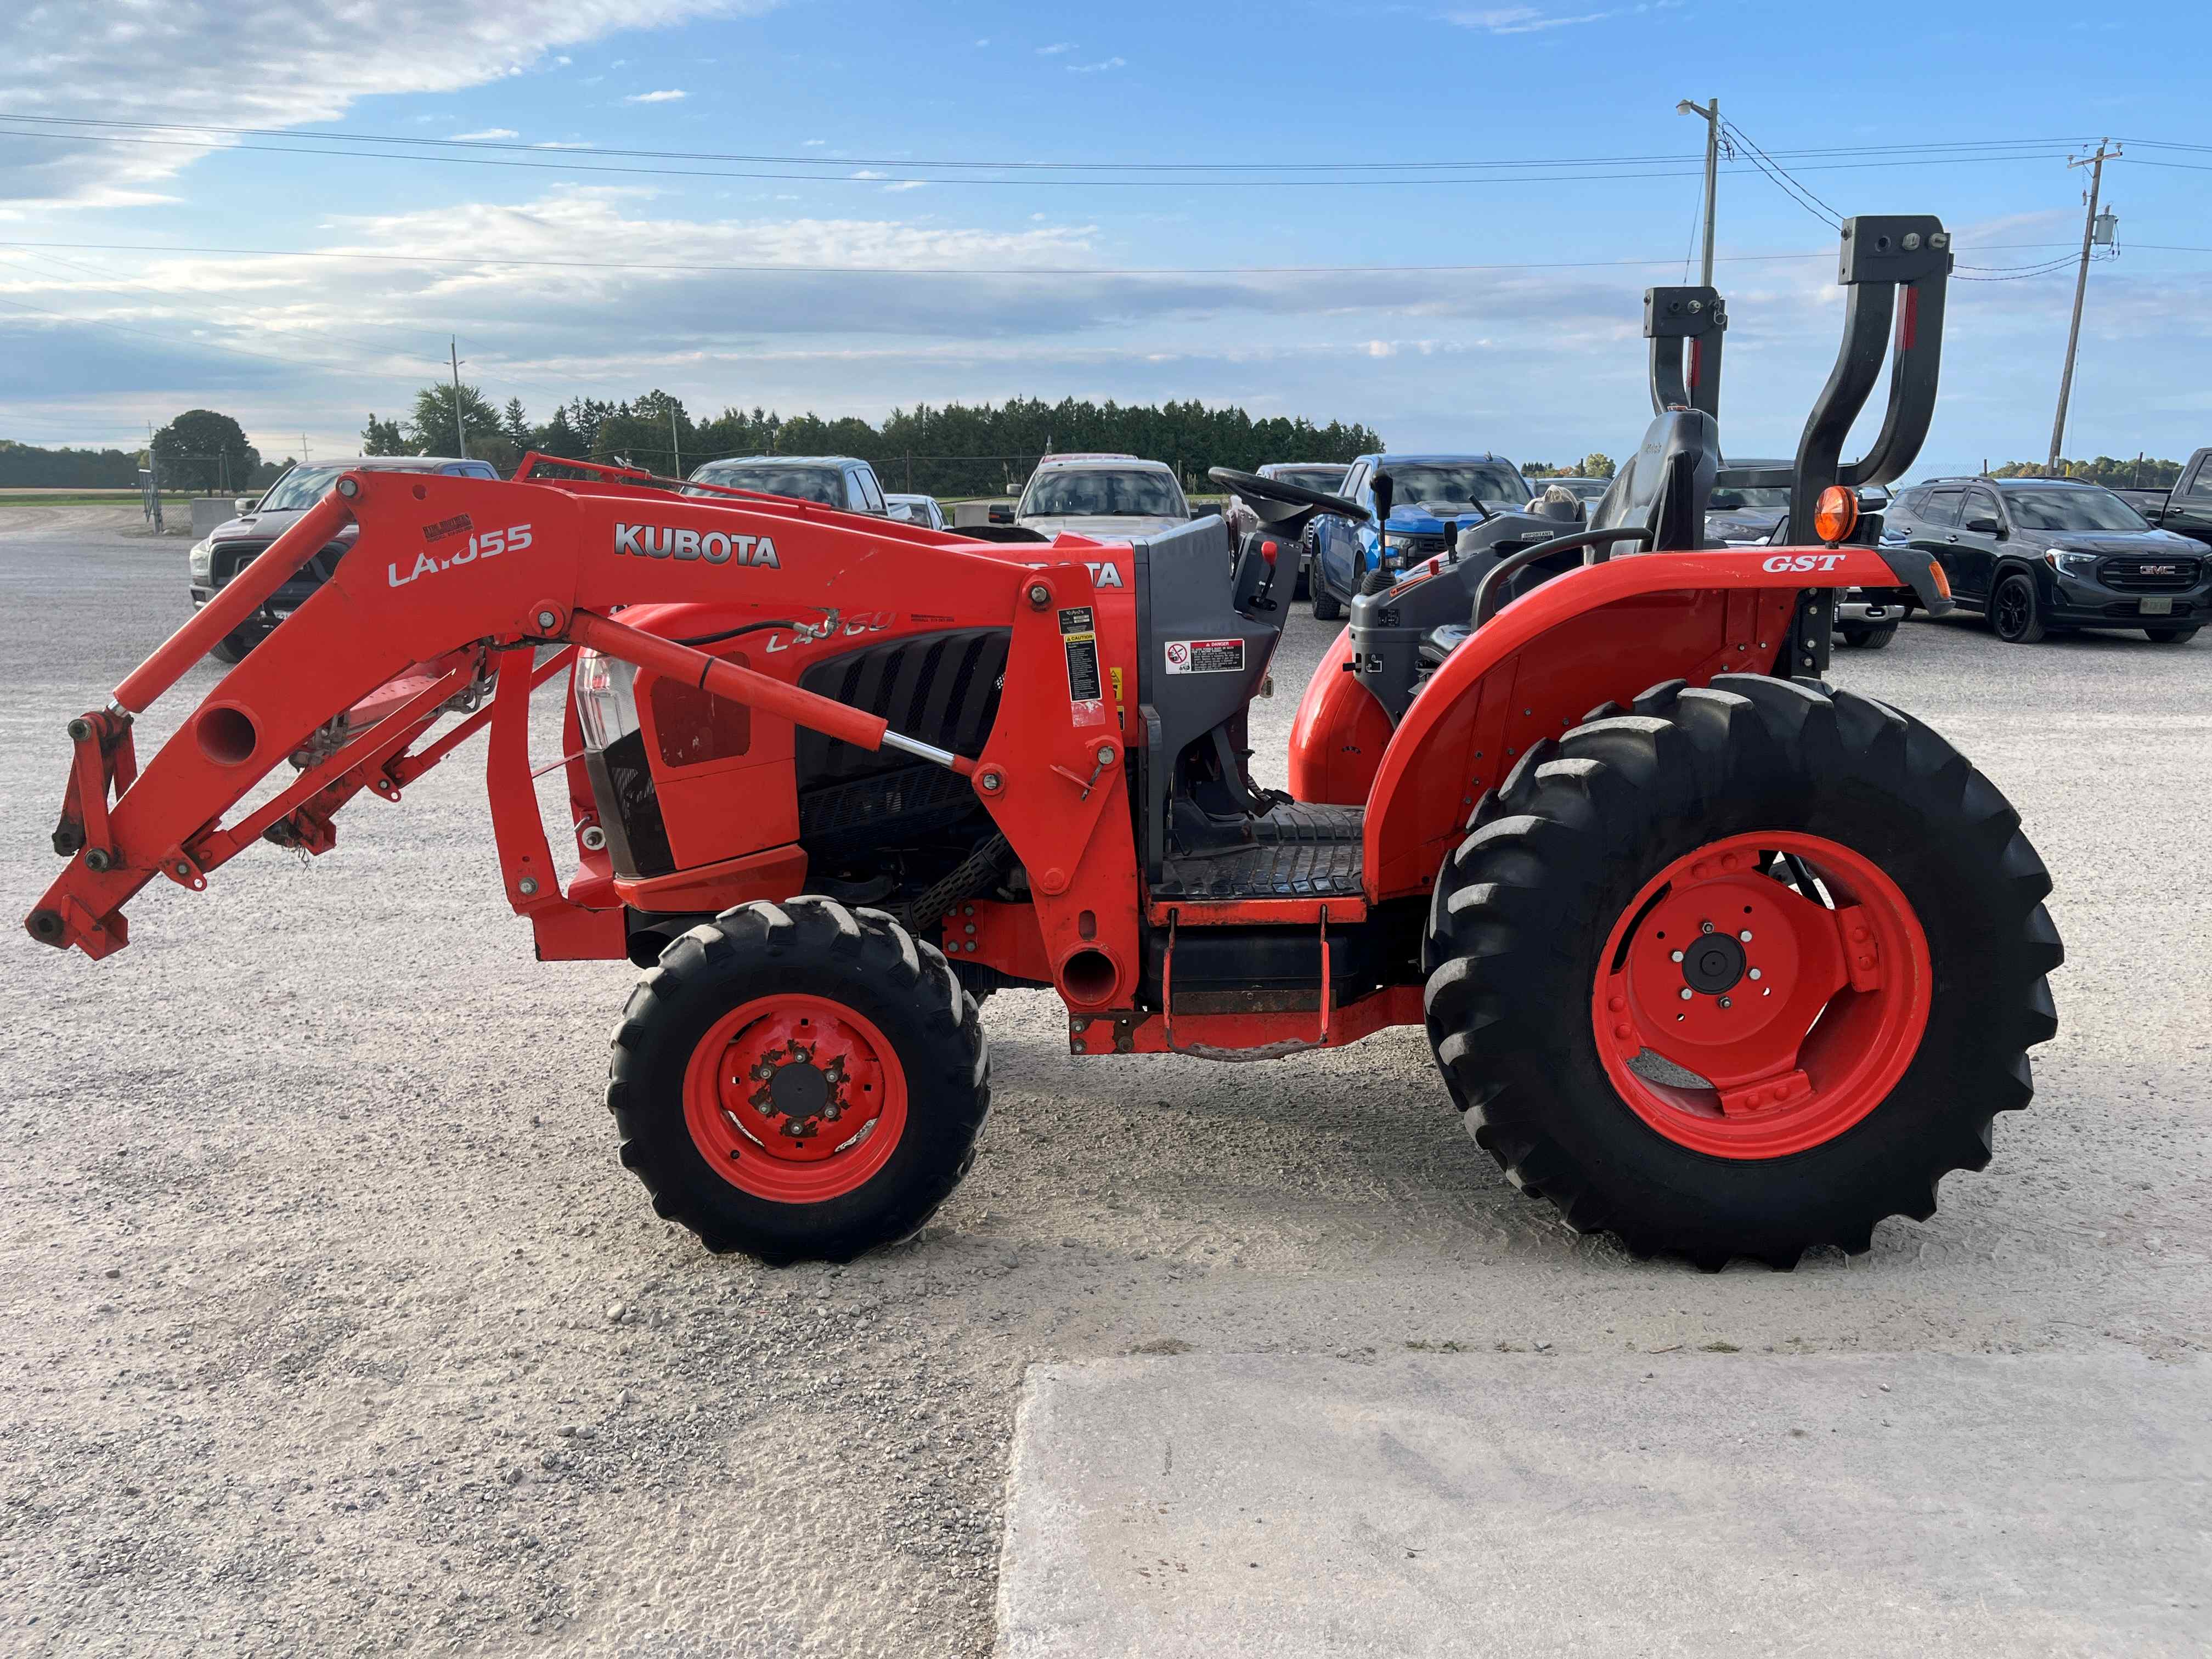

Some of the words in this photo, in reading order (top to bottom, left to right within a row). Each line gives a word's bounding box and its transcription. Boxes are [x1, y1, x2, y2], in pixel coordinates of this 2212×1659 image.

[614, 523, 781, 569] KUBOTA
[1763, 555, 1846, 573] GST
[2140, 566, 2176, 575] GMC
